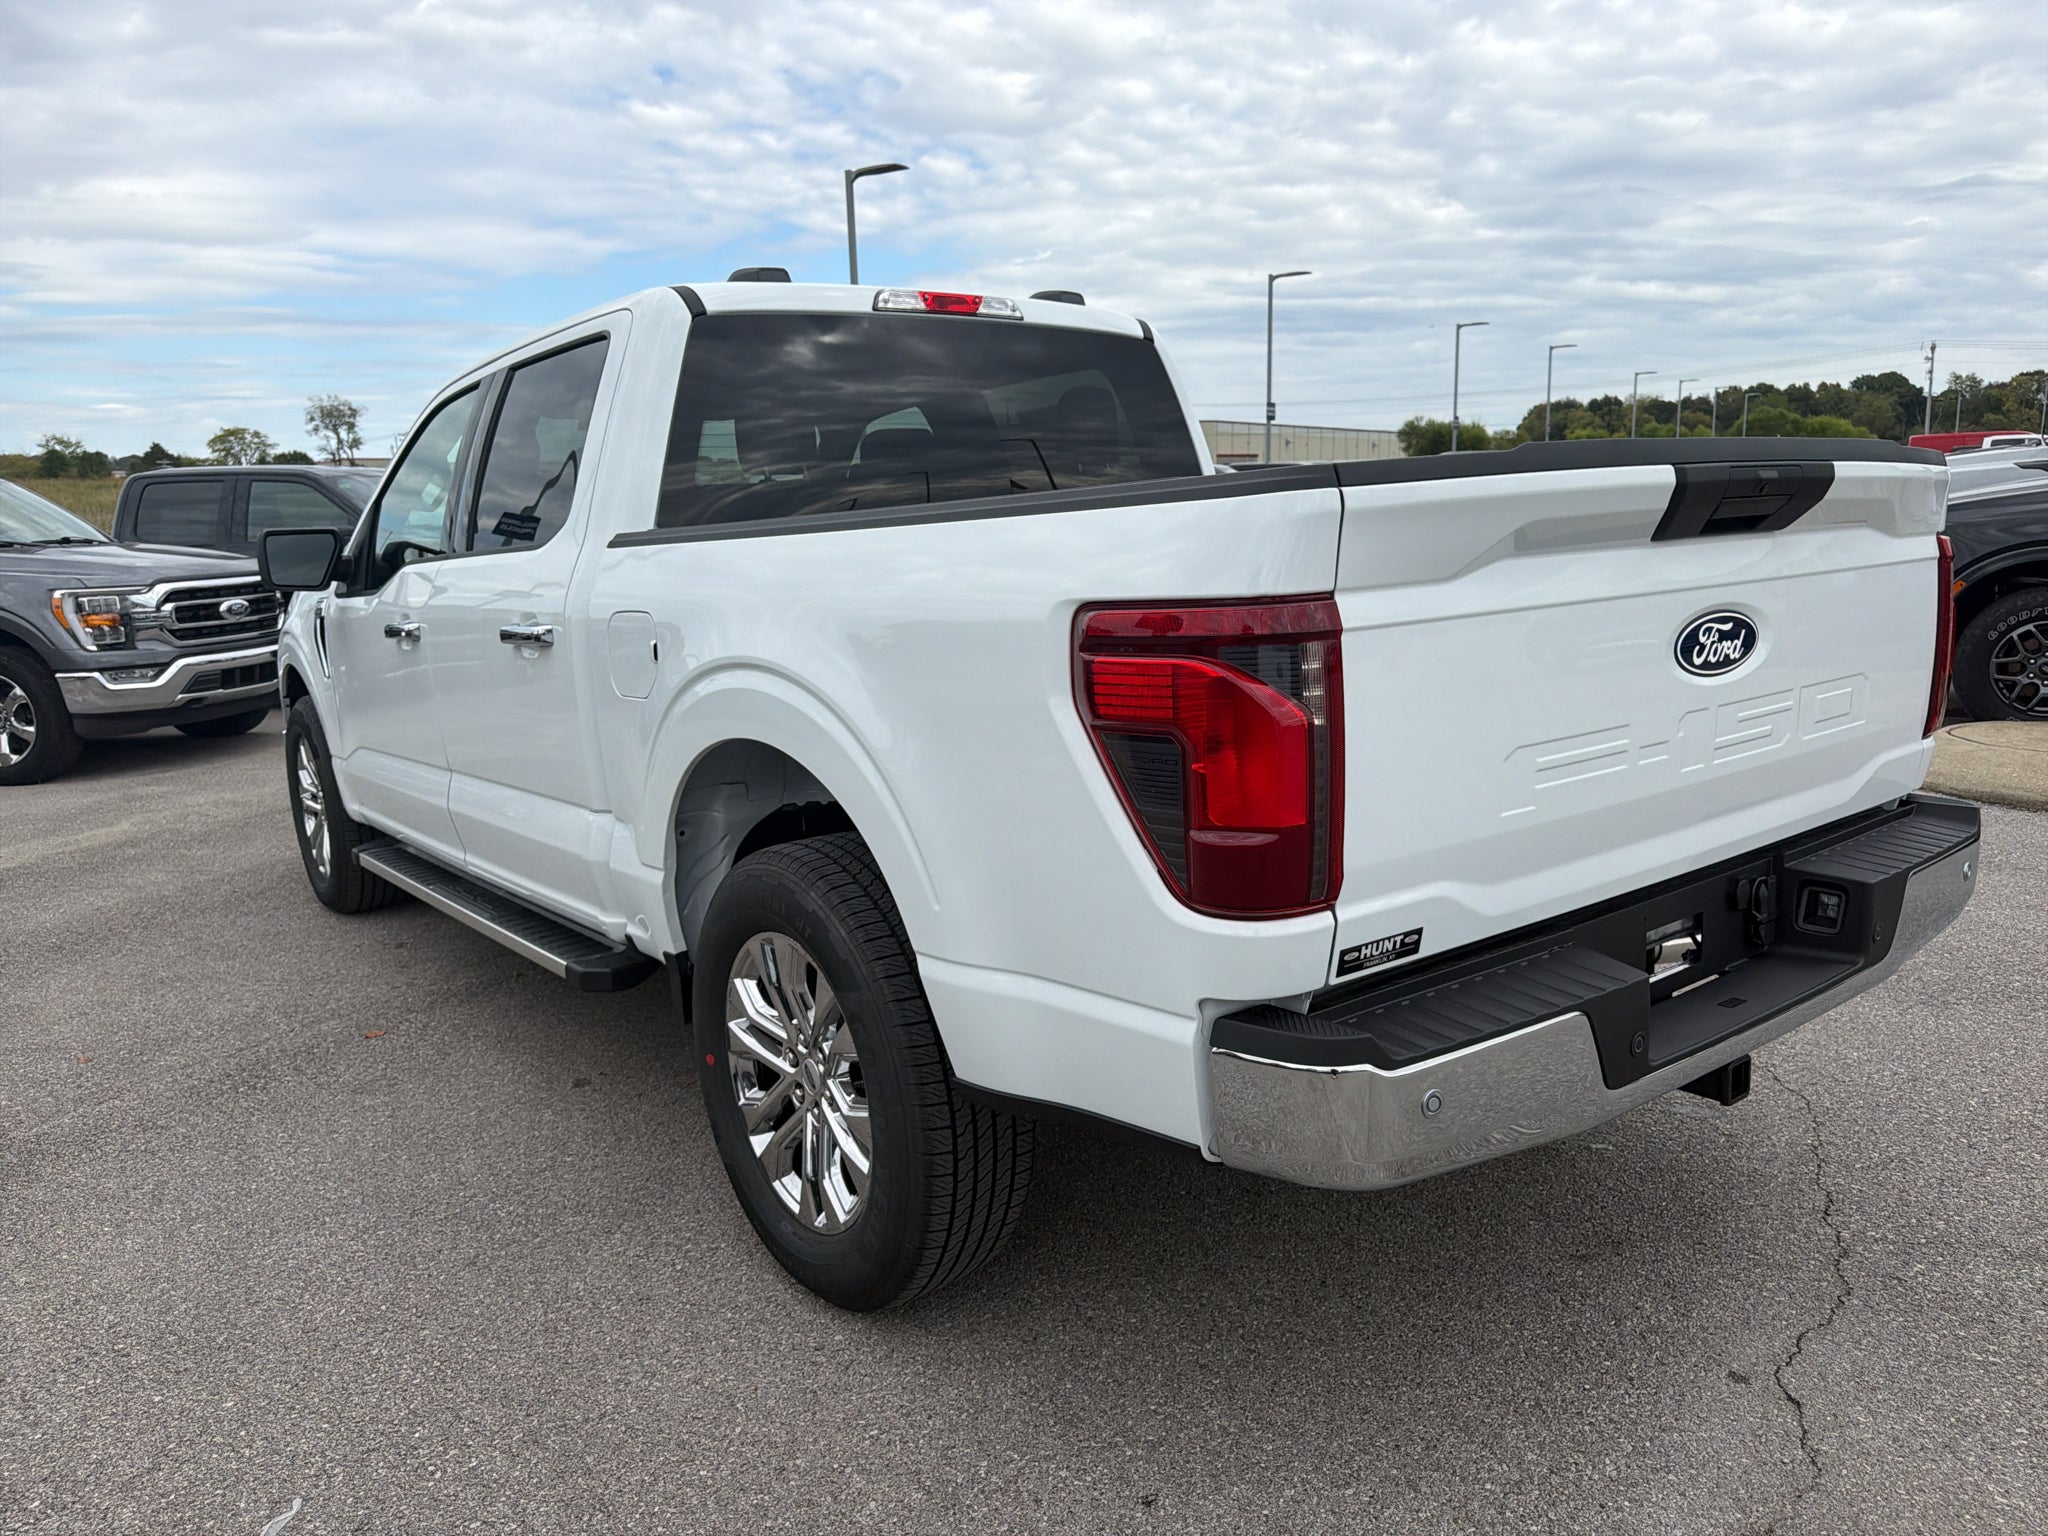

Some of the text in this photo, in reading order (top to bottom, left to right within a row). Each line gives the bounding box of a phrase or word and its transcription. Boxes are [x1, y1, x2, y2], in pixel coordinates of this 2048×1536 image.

[1692, 621, 1745, 666] Ford
[1500, 673, 1868, 817] F-150
[1360, 935, 1404, 959] HUNT
